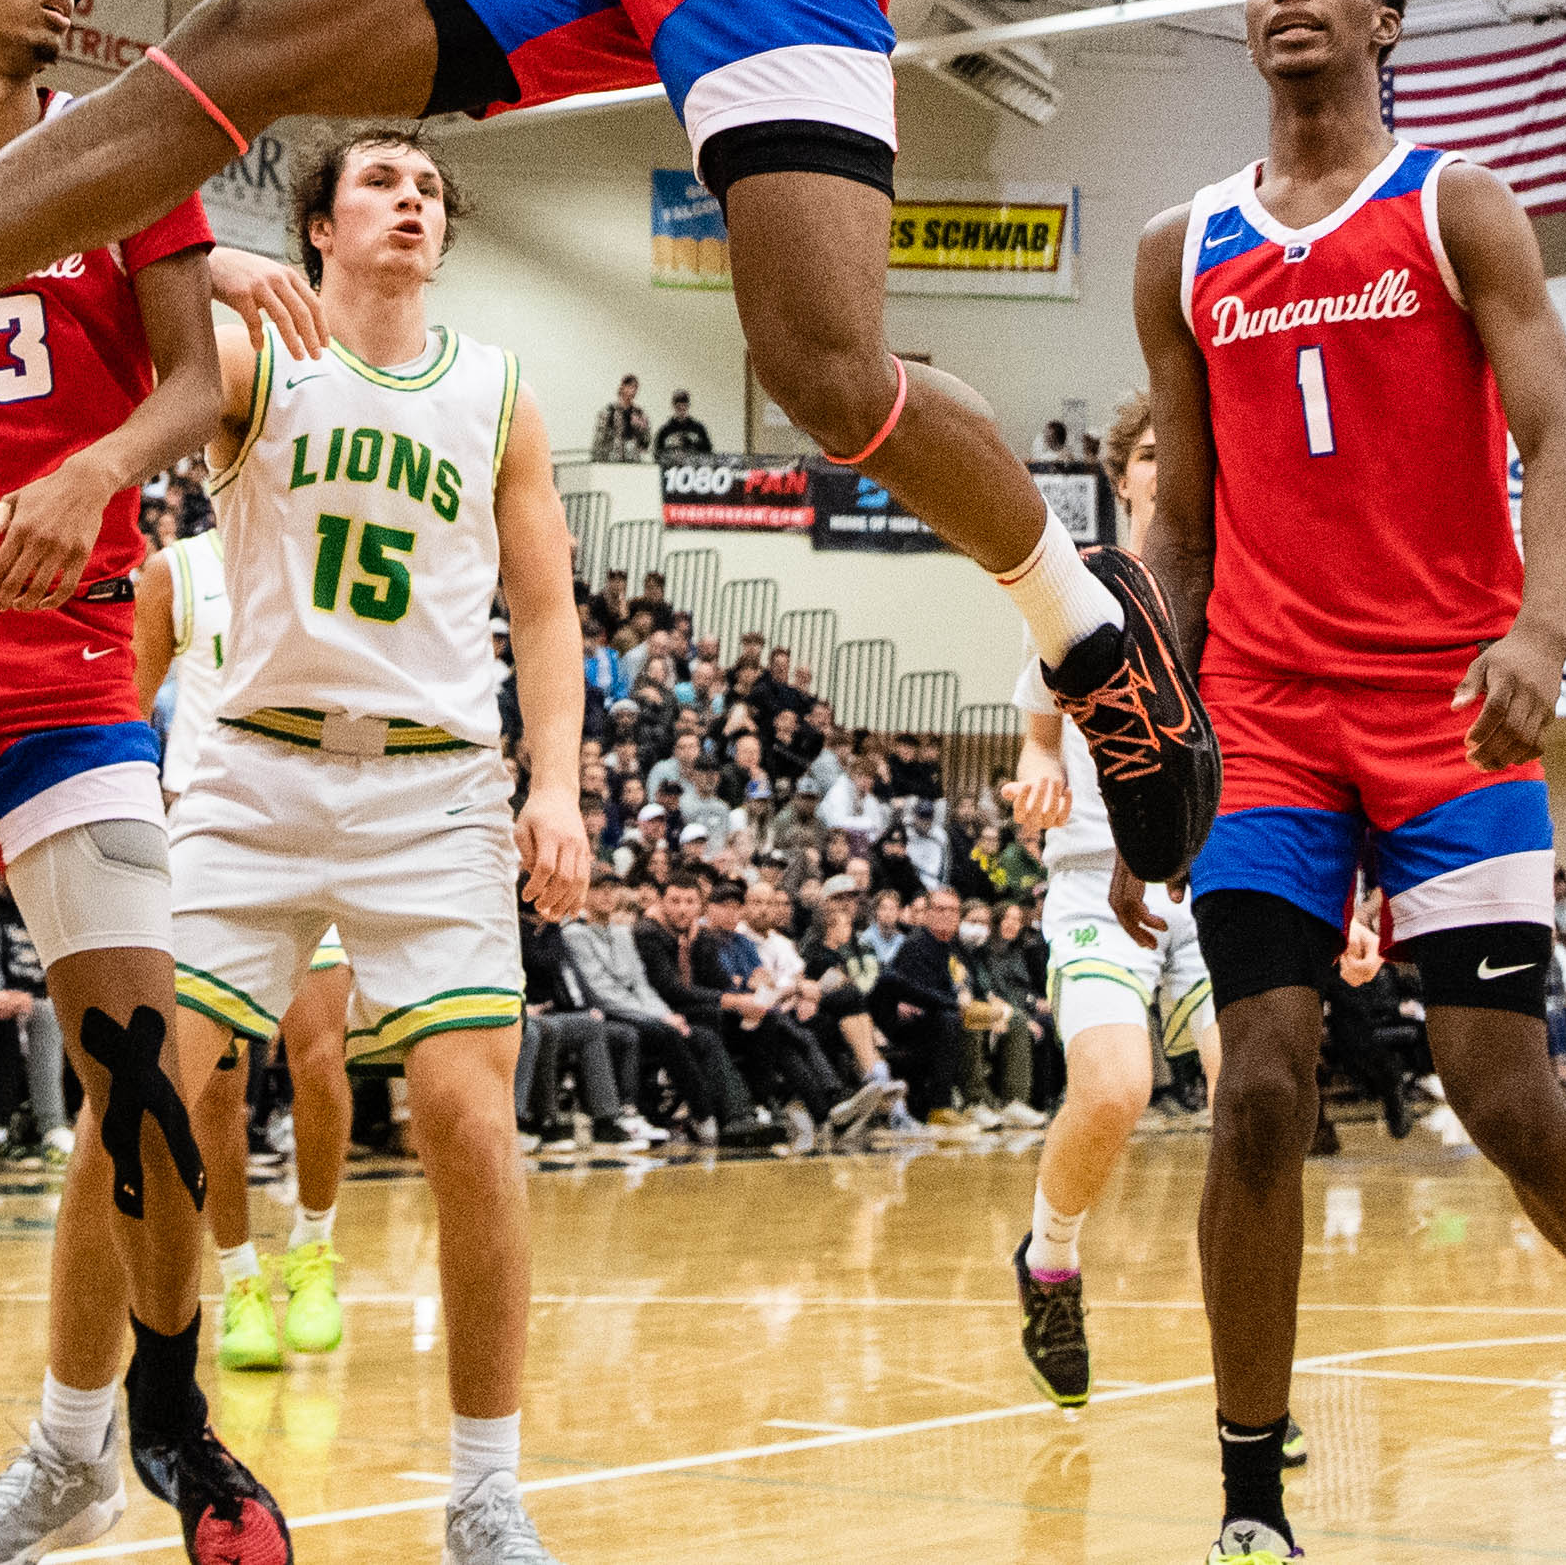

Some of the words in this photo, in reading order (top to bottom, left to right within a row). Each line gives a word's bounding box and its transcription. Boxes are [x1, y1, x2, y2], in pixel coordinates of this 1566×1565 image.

[922, 219, 1049, 251] SCHWAB
[1211, 268, 1421, 347] Duncanville
[1296, 345, 1335, 459] 1
[289, 427, 463, 523] LIONS
[664, 466, 734, 494] 1080
[312, 511, 417, 625] 15
